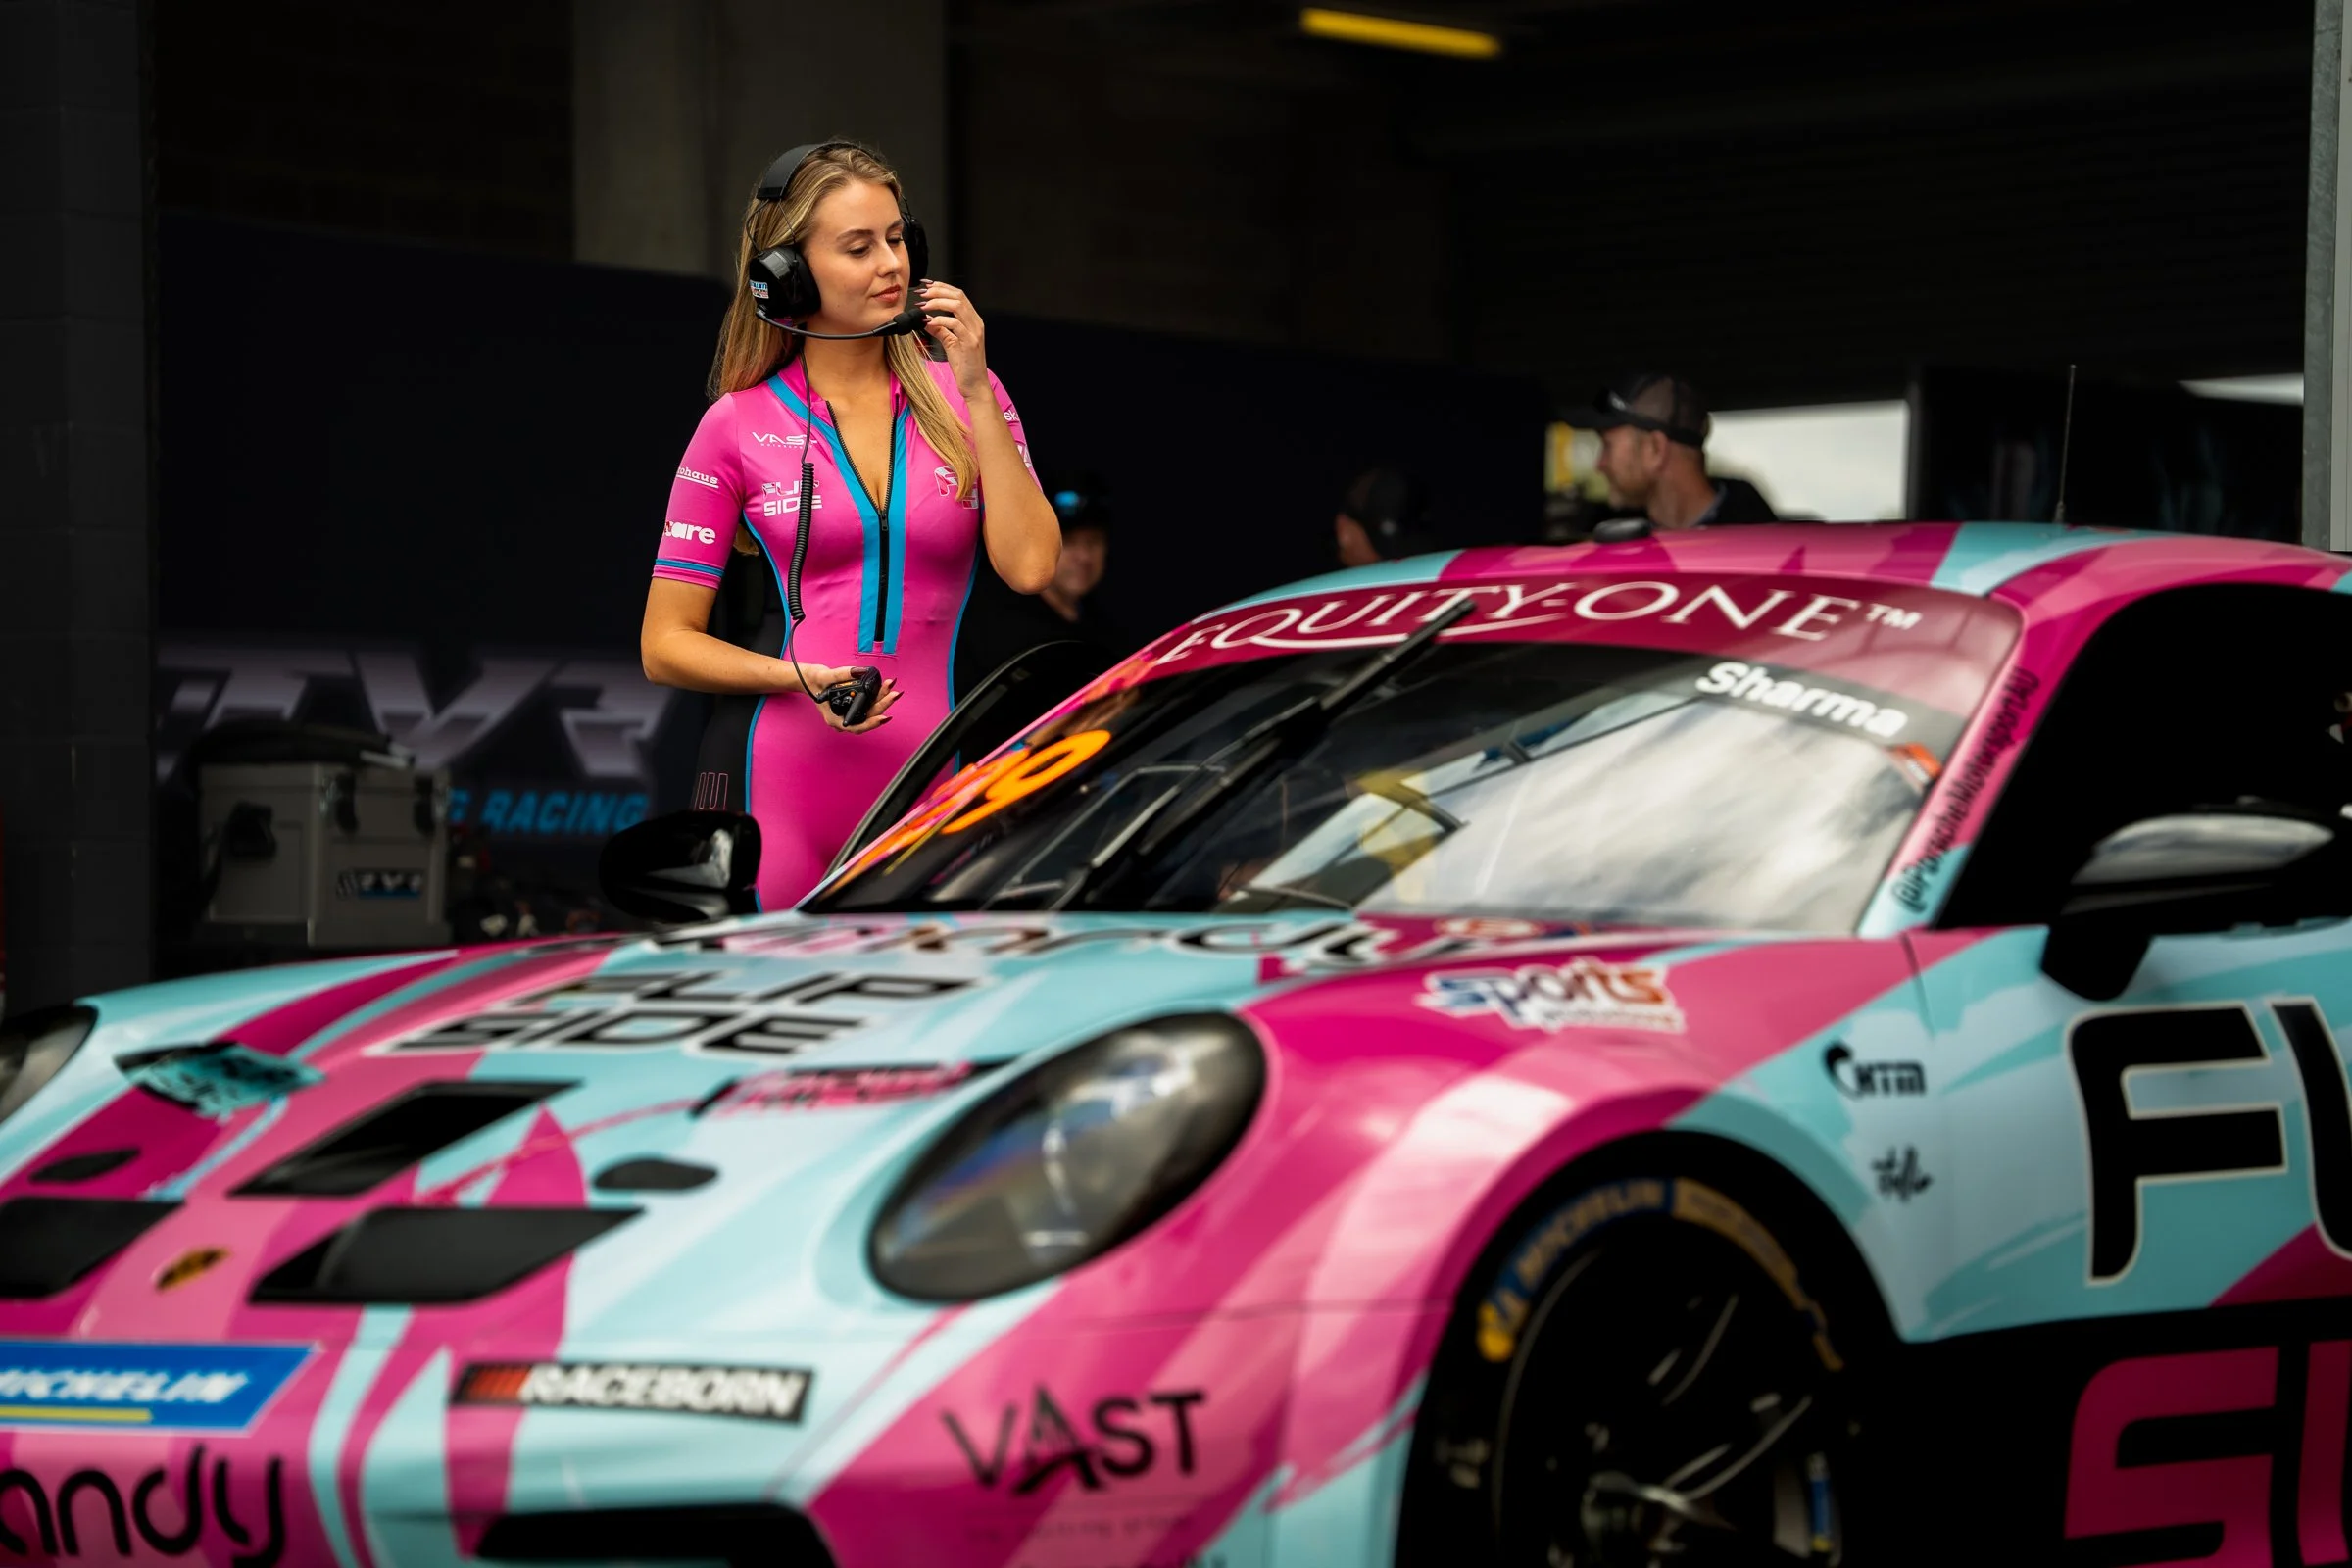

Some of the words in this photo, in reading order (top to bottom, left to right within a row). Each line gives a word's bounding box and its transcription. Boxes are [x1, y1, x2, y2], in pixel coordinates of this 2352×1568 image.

[1694, 661, 1909, 738] Sharma
[481, 789, 650, 833] RACING
[495, 970, 990, 1008] FLIP
[382, 1004, 874, 1054] SIDE
[518, 1363, 808, 1417] RACEBORN
[940, 1386, 1205, 1495] VAST
